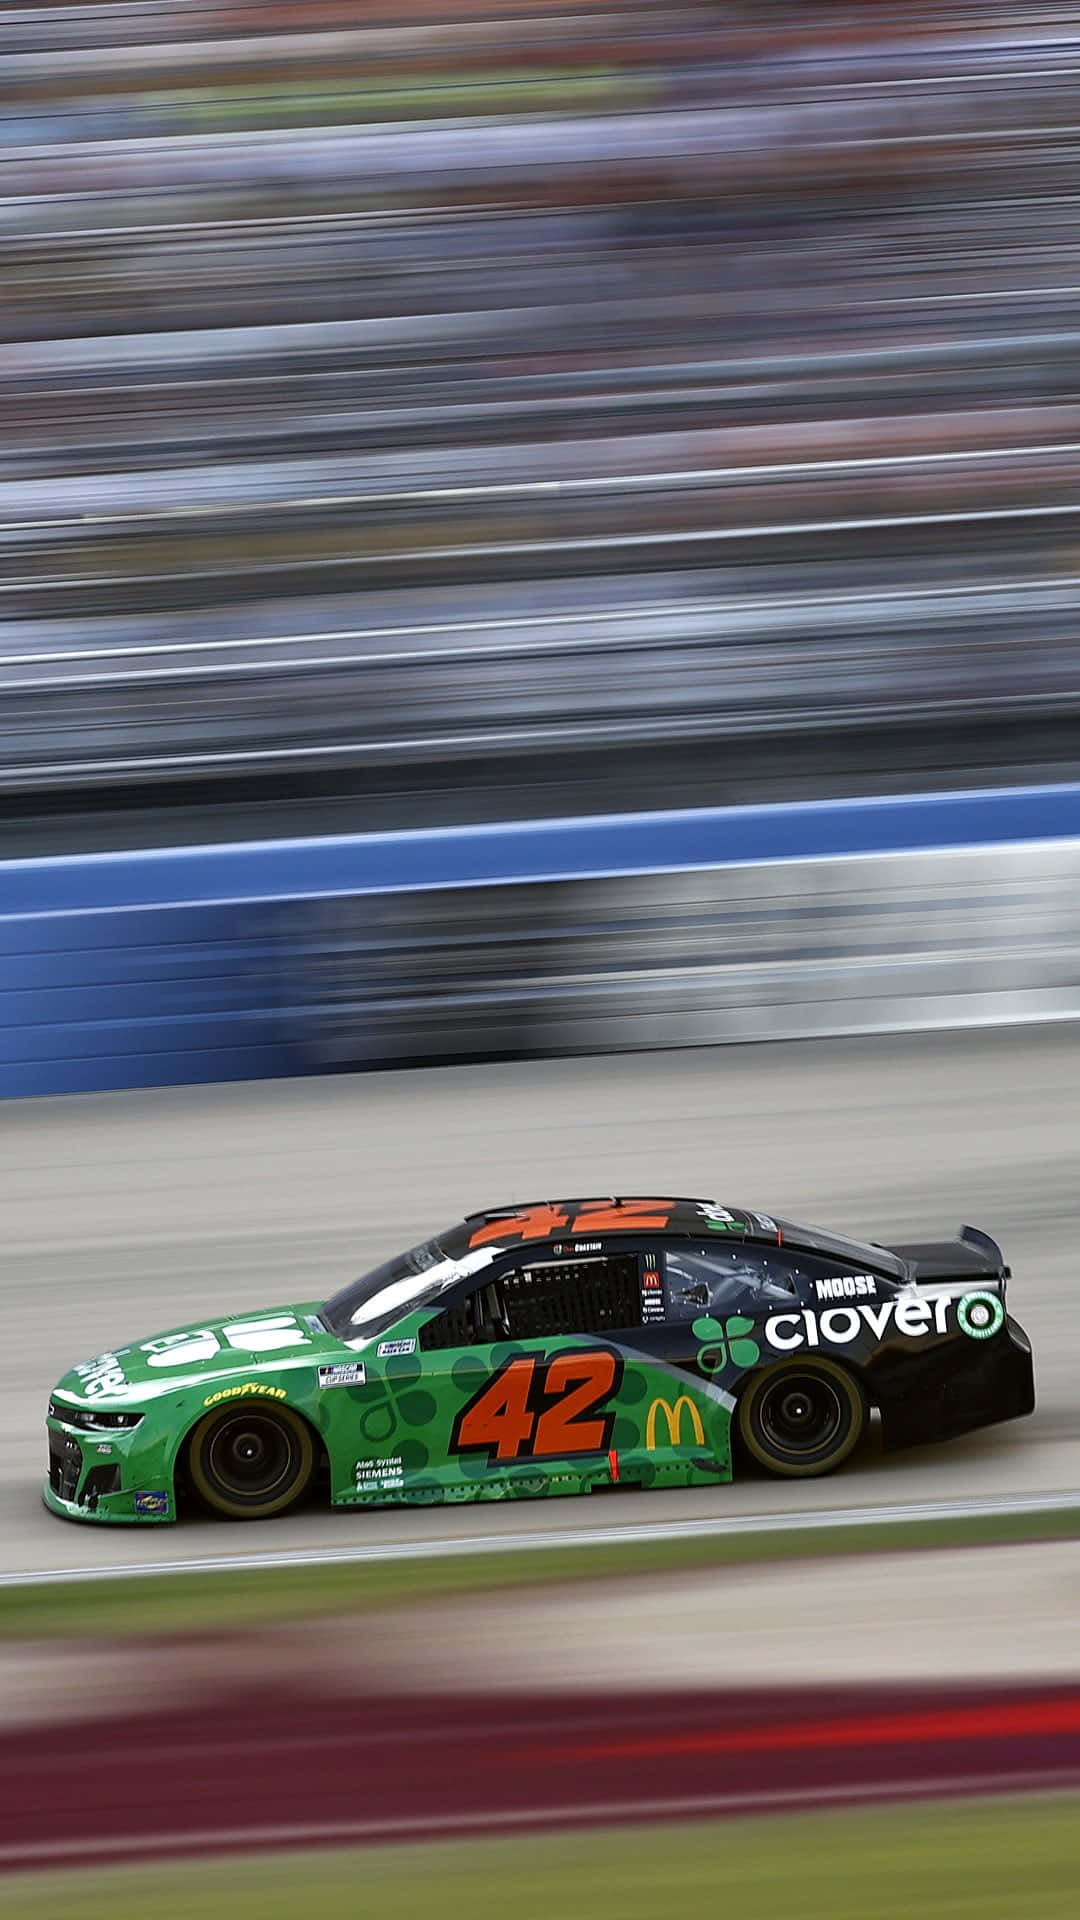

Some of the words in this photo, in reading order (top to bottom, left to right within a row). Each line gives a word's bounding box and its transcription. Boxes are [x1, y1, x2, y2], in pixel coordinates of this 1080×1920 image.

[468, 1200, 675, 1248] 42
[815, 1275, 877, 1299] MOOSE
[765, 1296, 952, 1350] clover
[203, 1382, 287, 1406] GOODYEAR
[457, 1351, 617, 1459] 42
[356, 1466, 403, 1480] SIEMENS
